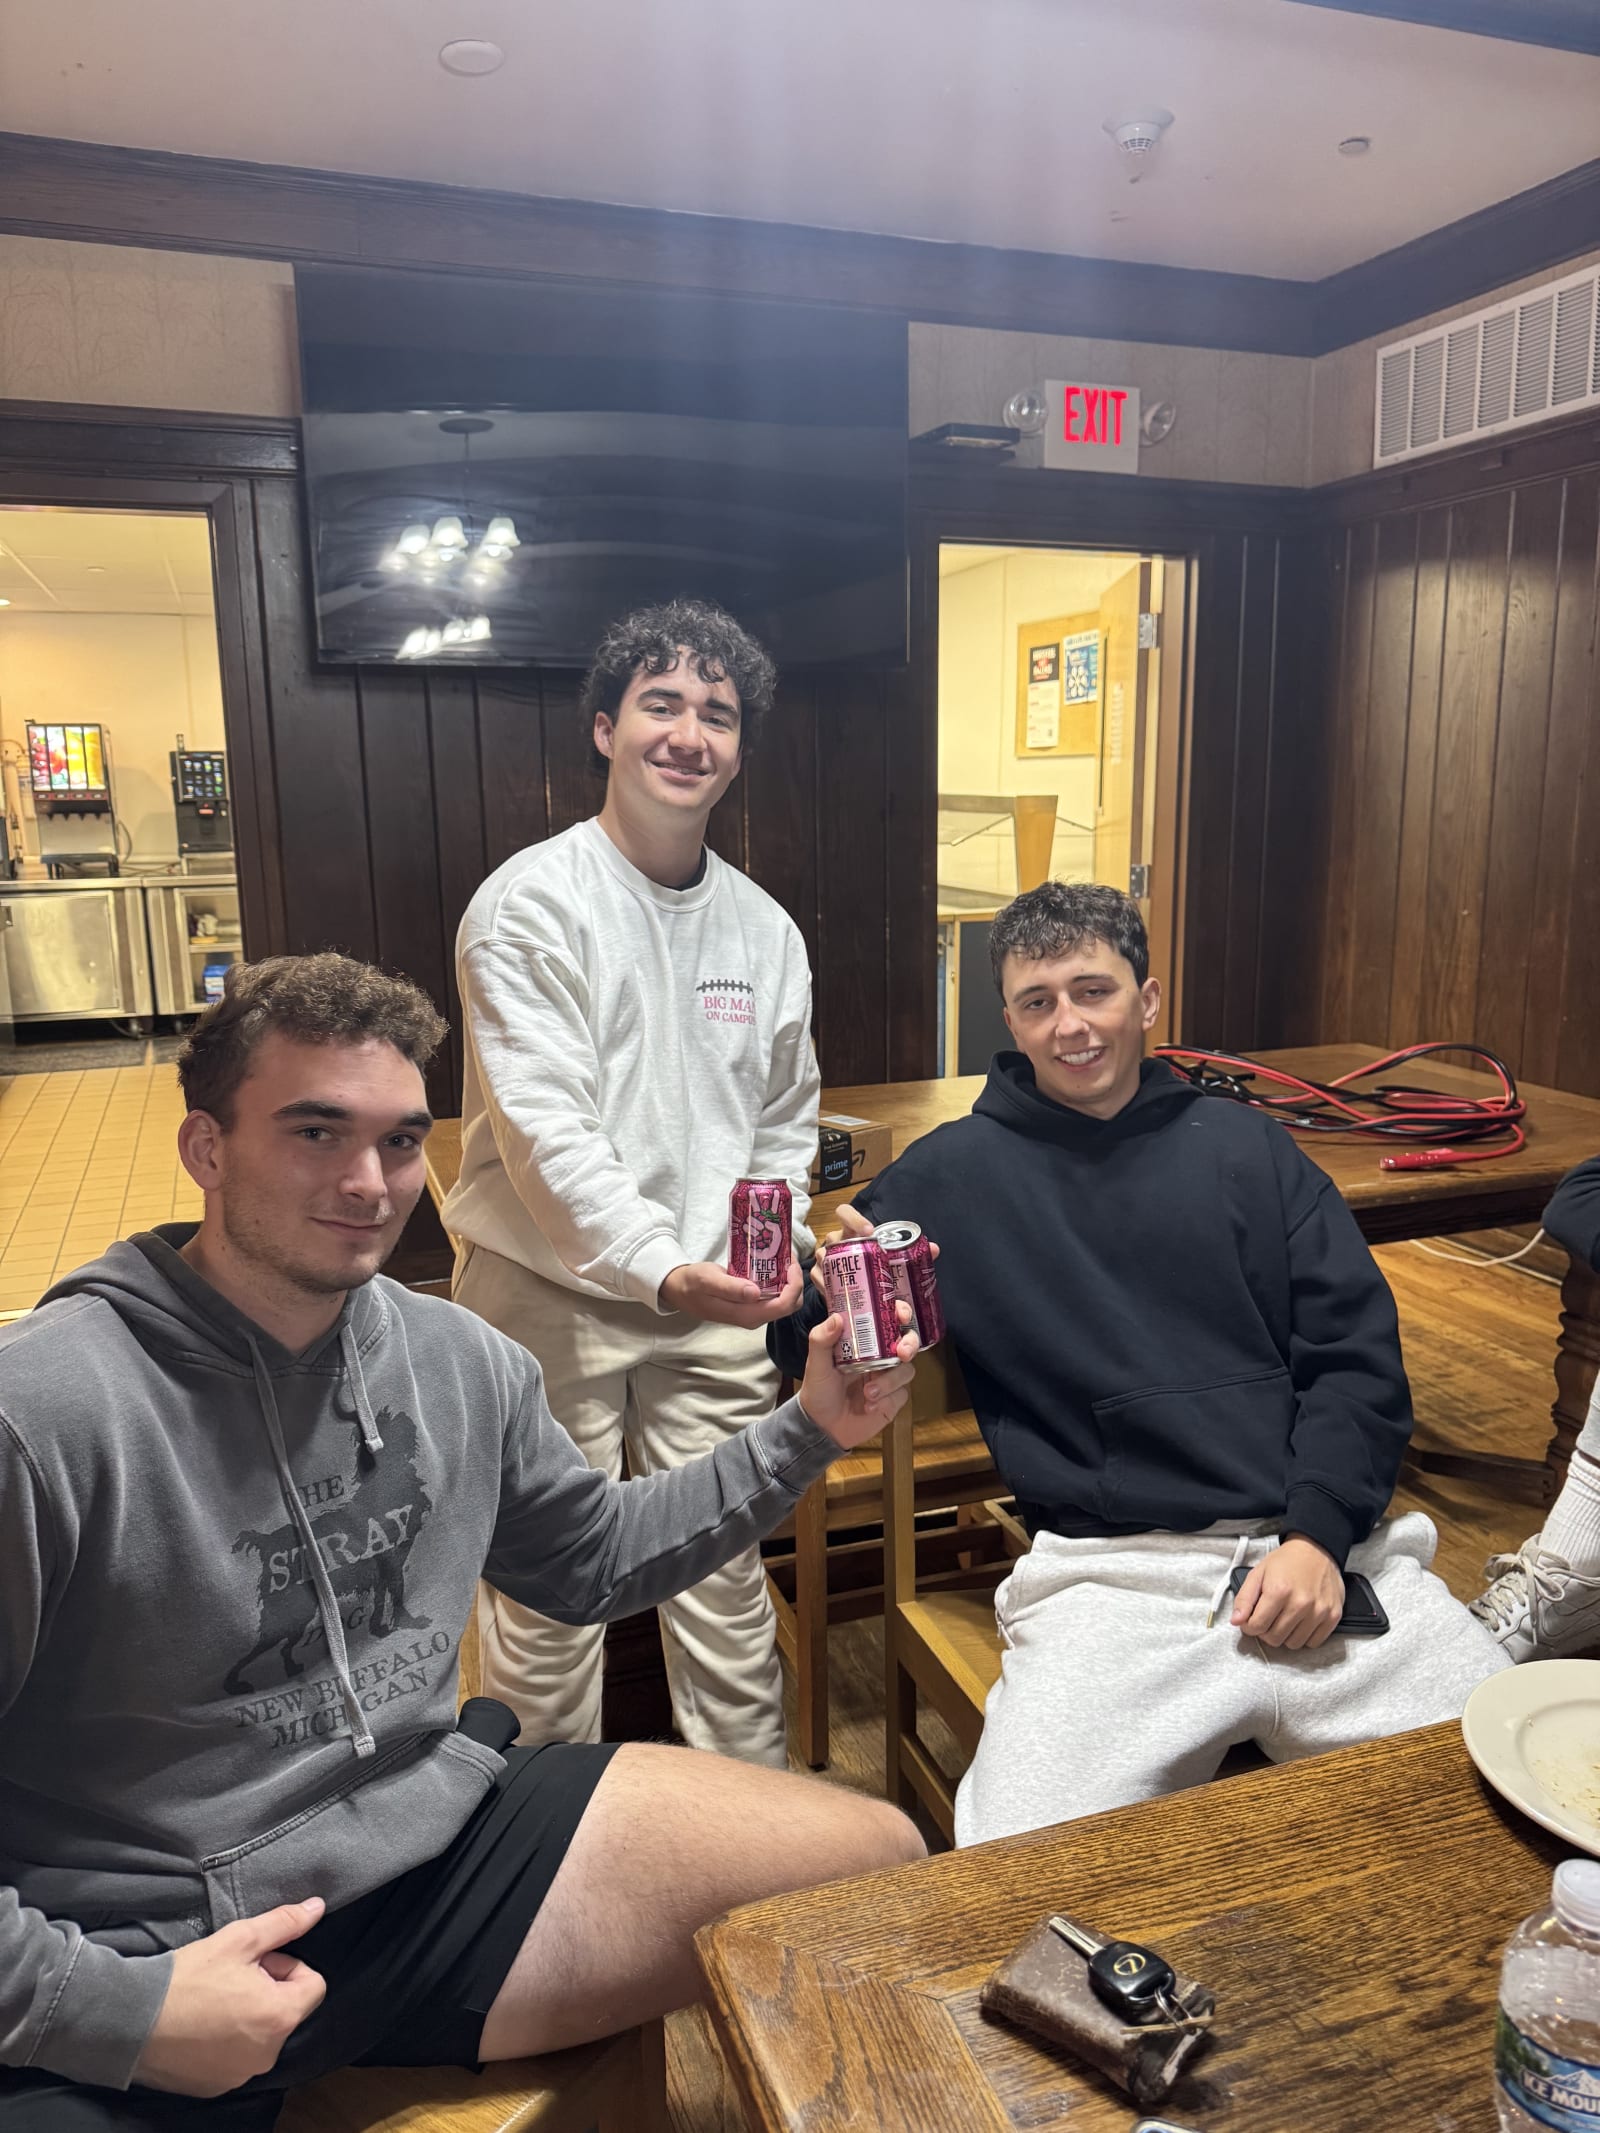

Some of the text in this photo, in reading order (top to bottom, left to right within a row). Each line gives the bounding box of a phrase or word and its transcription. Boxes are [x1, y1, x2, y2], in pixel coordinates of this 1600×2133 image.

[1064, 387, 1128, 446] EXIT
[703, 996, 755, 1014] BIG MA
[706, 1011, 720, 1021] ON
[825, 1160, 848, 1175] prime
[751, 1259, 776, 1271] PEACE
[831, 1255, 861, 1275] PEACE
[756, 1271, 772, 1281] TEA
[837, 1272, 857, 1287] TEA
[297, 1475, 345, 1509] HE
[234, 1688, 303, 1728] NEW
[271, 1666, 430, 1750] MICHGAN
[1523, 2072, 1600, 2113] ICE MOU
